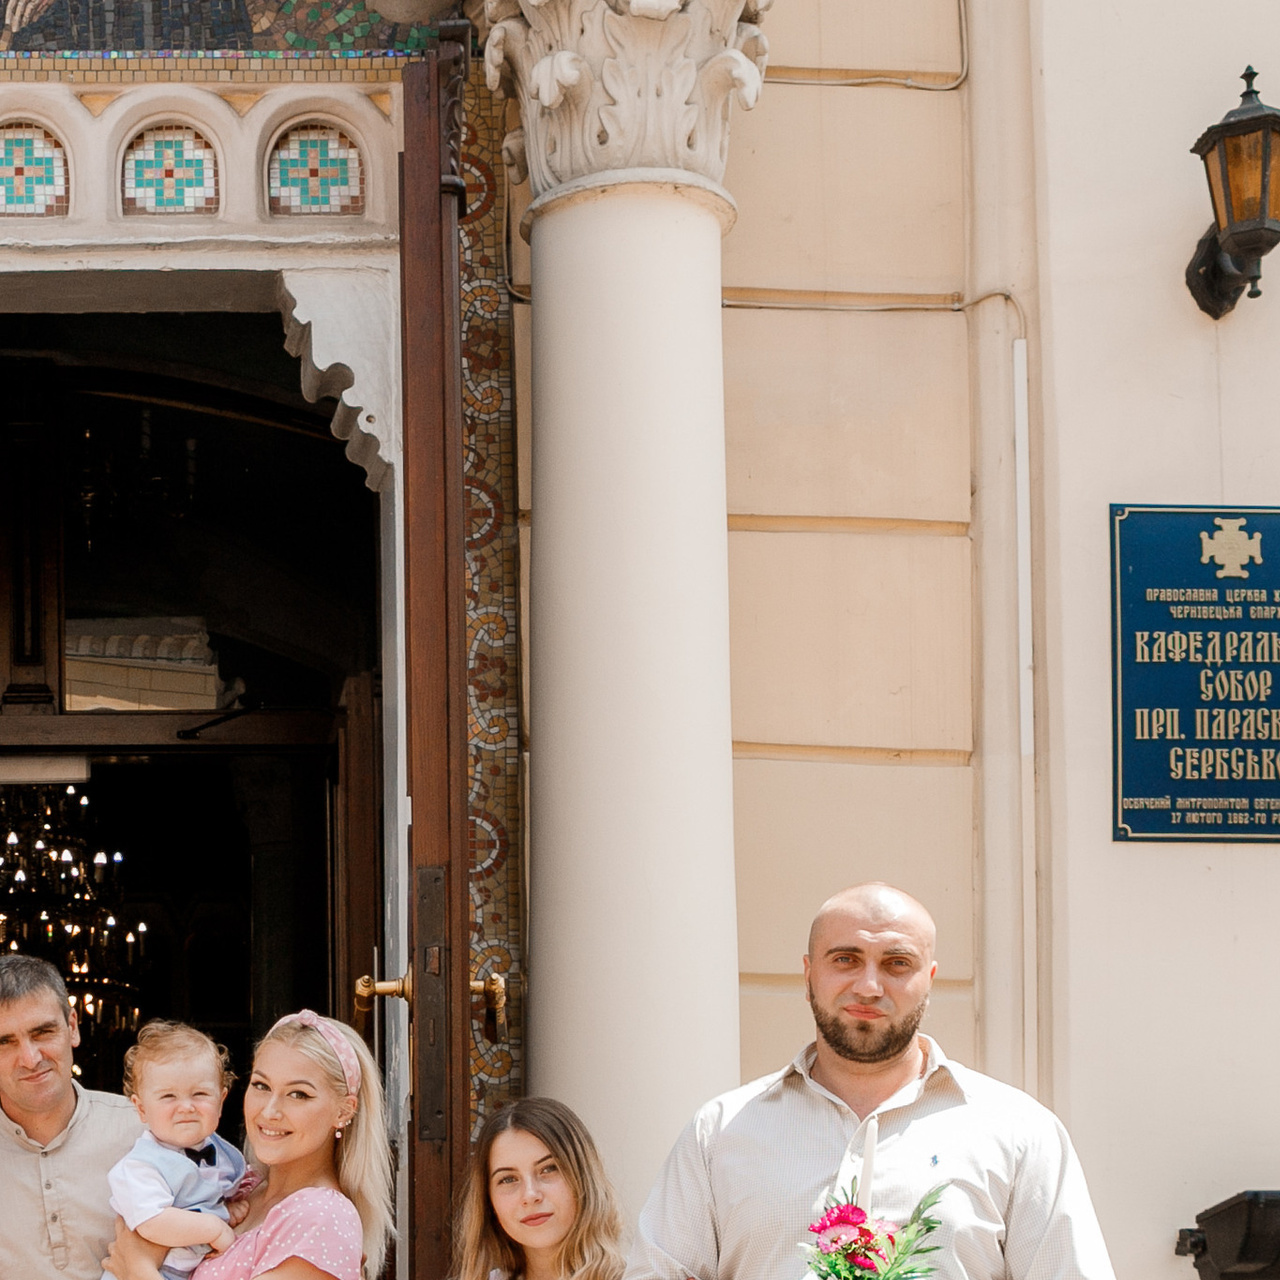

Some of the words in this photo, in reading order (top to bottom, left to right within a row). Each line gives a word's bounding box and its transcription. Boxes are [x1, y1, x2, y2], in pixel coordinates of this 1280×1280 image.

[1146, 588, 1218, 602] ПРАВОСЛАВНА
[1226, 589, 1267, 604] ЦЕРКВА
[1170, 606, 1243, 620] ЧЕРНІВЕЦЬКА
[1200, 669, 1272, 701] СОБОР
[1135, 708, 1186, 740] ПРП.
[1171, 812, 1182, 824] 17
